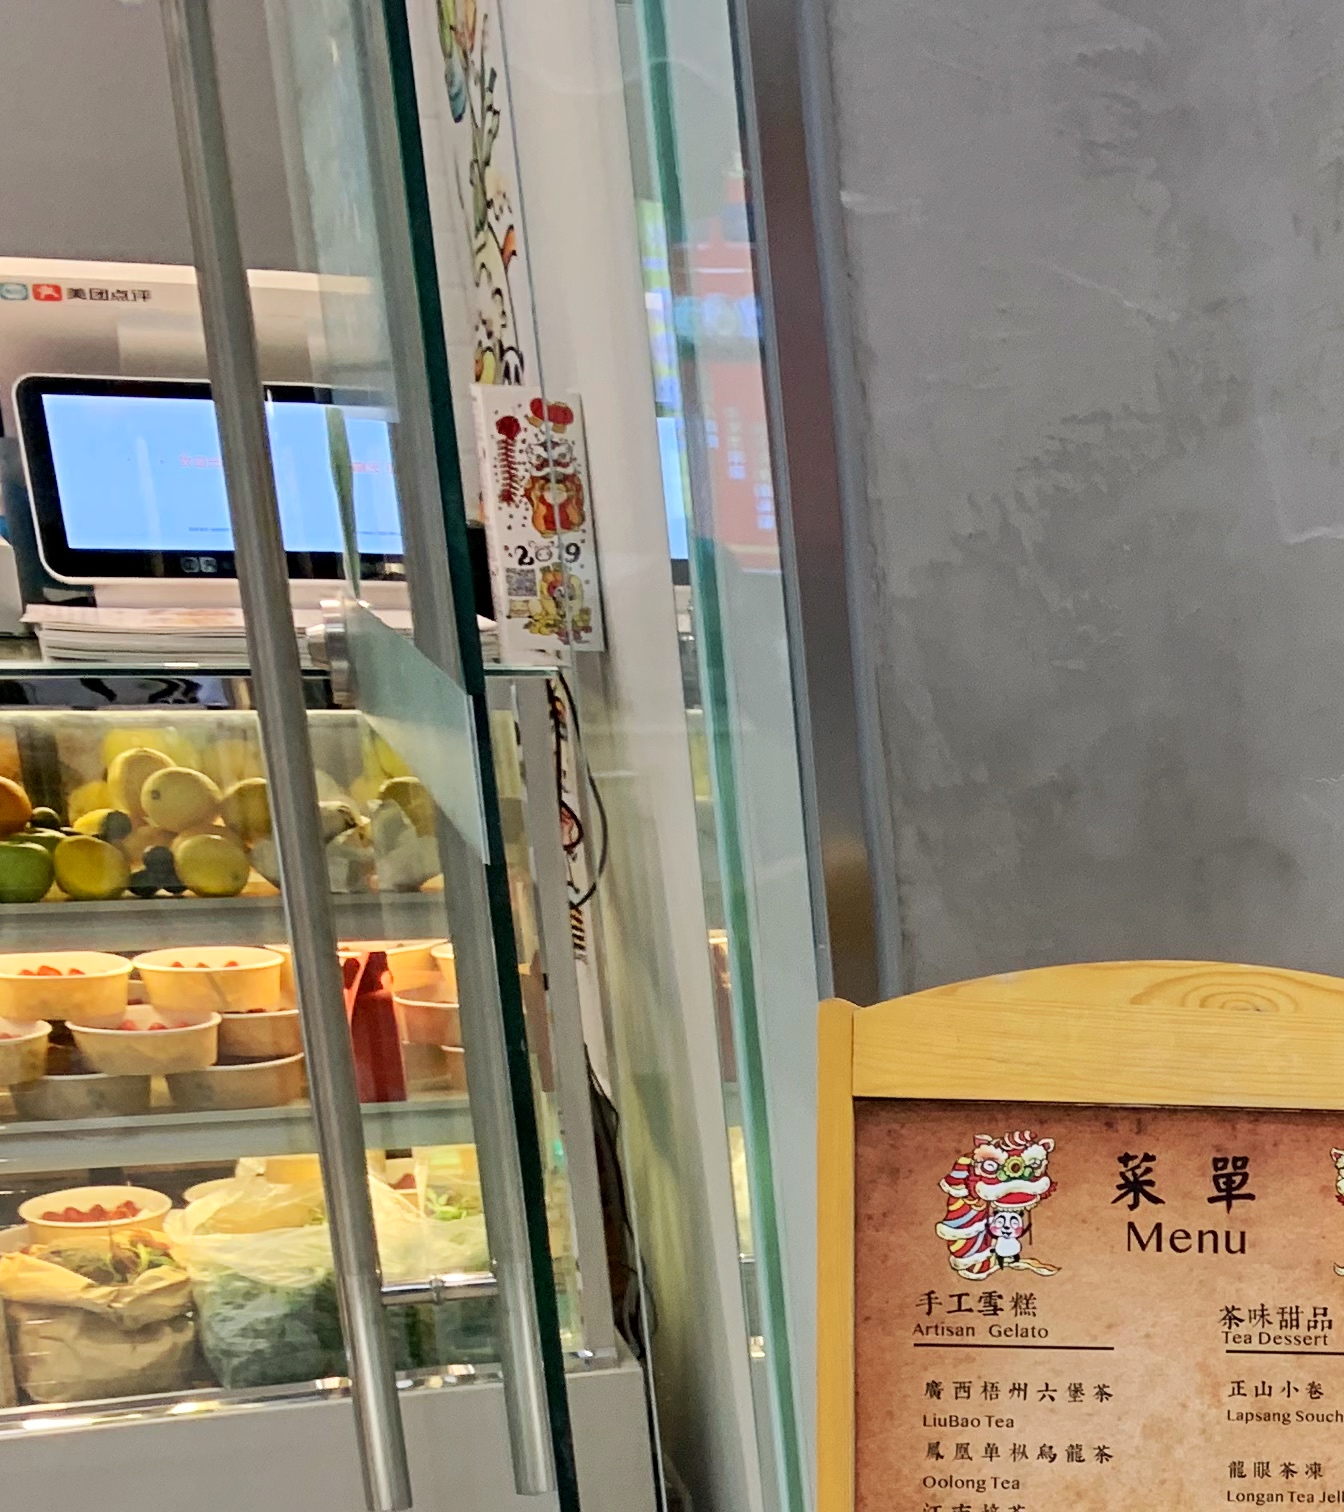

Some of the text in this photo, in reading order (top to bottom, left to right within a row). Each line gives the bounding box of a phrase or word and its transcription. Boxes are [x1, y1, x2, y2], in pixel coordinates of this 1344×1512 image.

[1111, 1151, 1257, 1213] 菜單
[1126, 1221, 1247, 1255] Menu
[915, 1290, 1037, 1318] 手工雪糕
[1218, 1303, 1333, 1332] 茶味甜品
[912, 1322, 1049, 1340] Artisan Gelato
[1222, 1331, 1328, 1346] Tea Dessert
[924, 1380, 1113, 1403] 廣西梧州六堡茶
[1228, 1380, 1324, 1400] 正山小卷
[923, 1414, 1014, 1428] LiuBao Tea
[1227, 1409, 1291, 1425] Lapsang
[923, 1475, 1020, 1493] Oolong Tea
[1227, 1490, 1283, 1505] Longan
[1288, 1491, 1314, 1503] Tea
